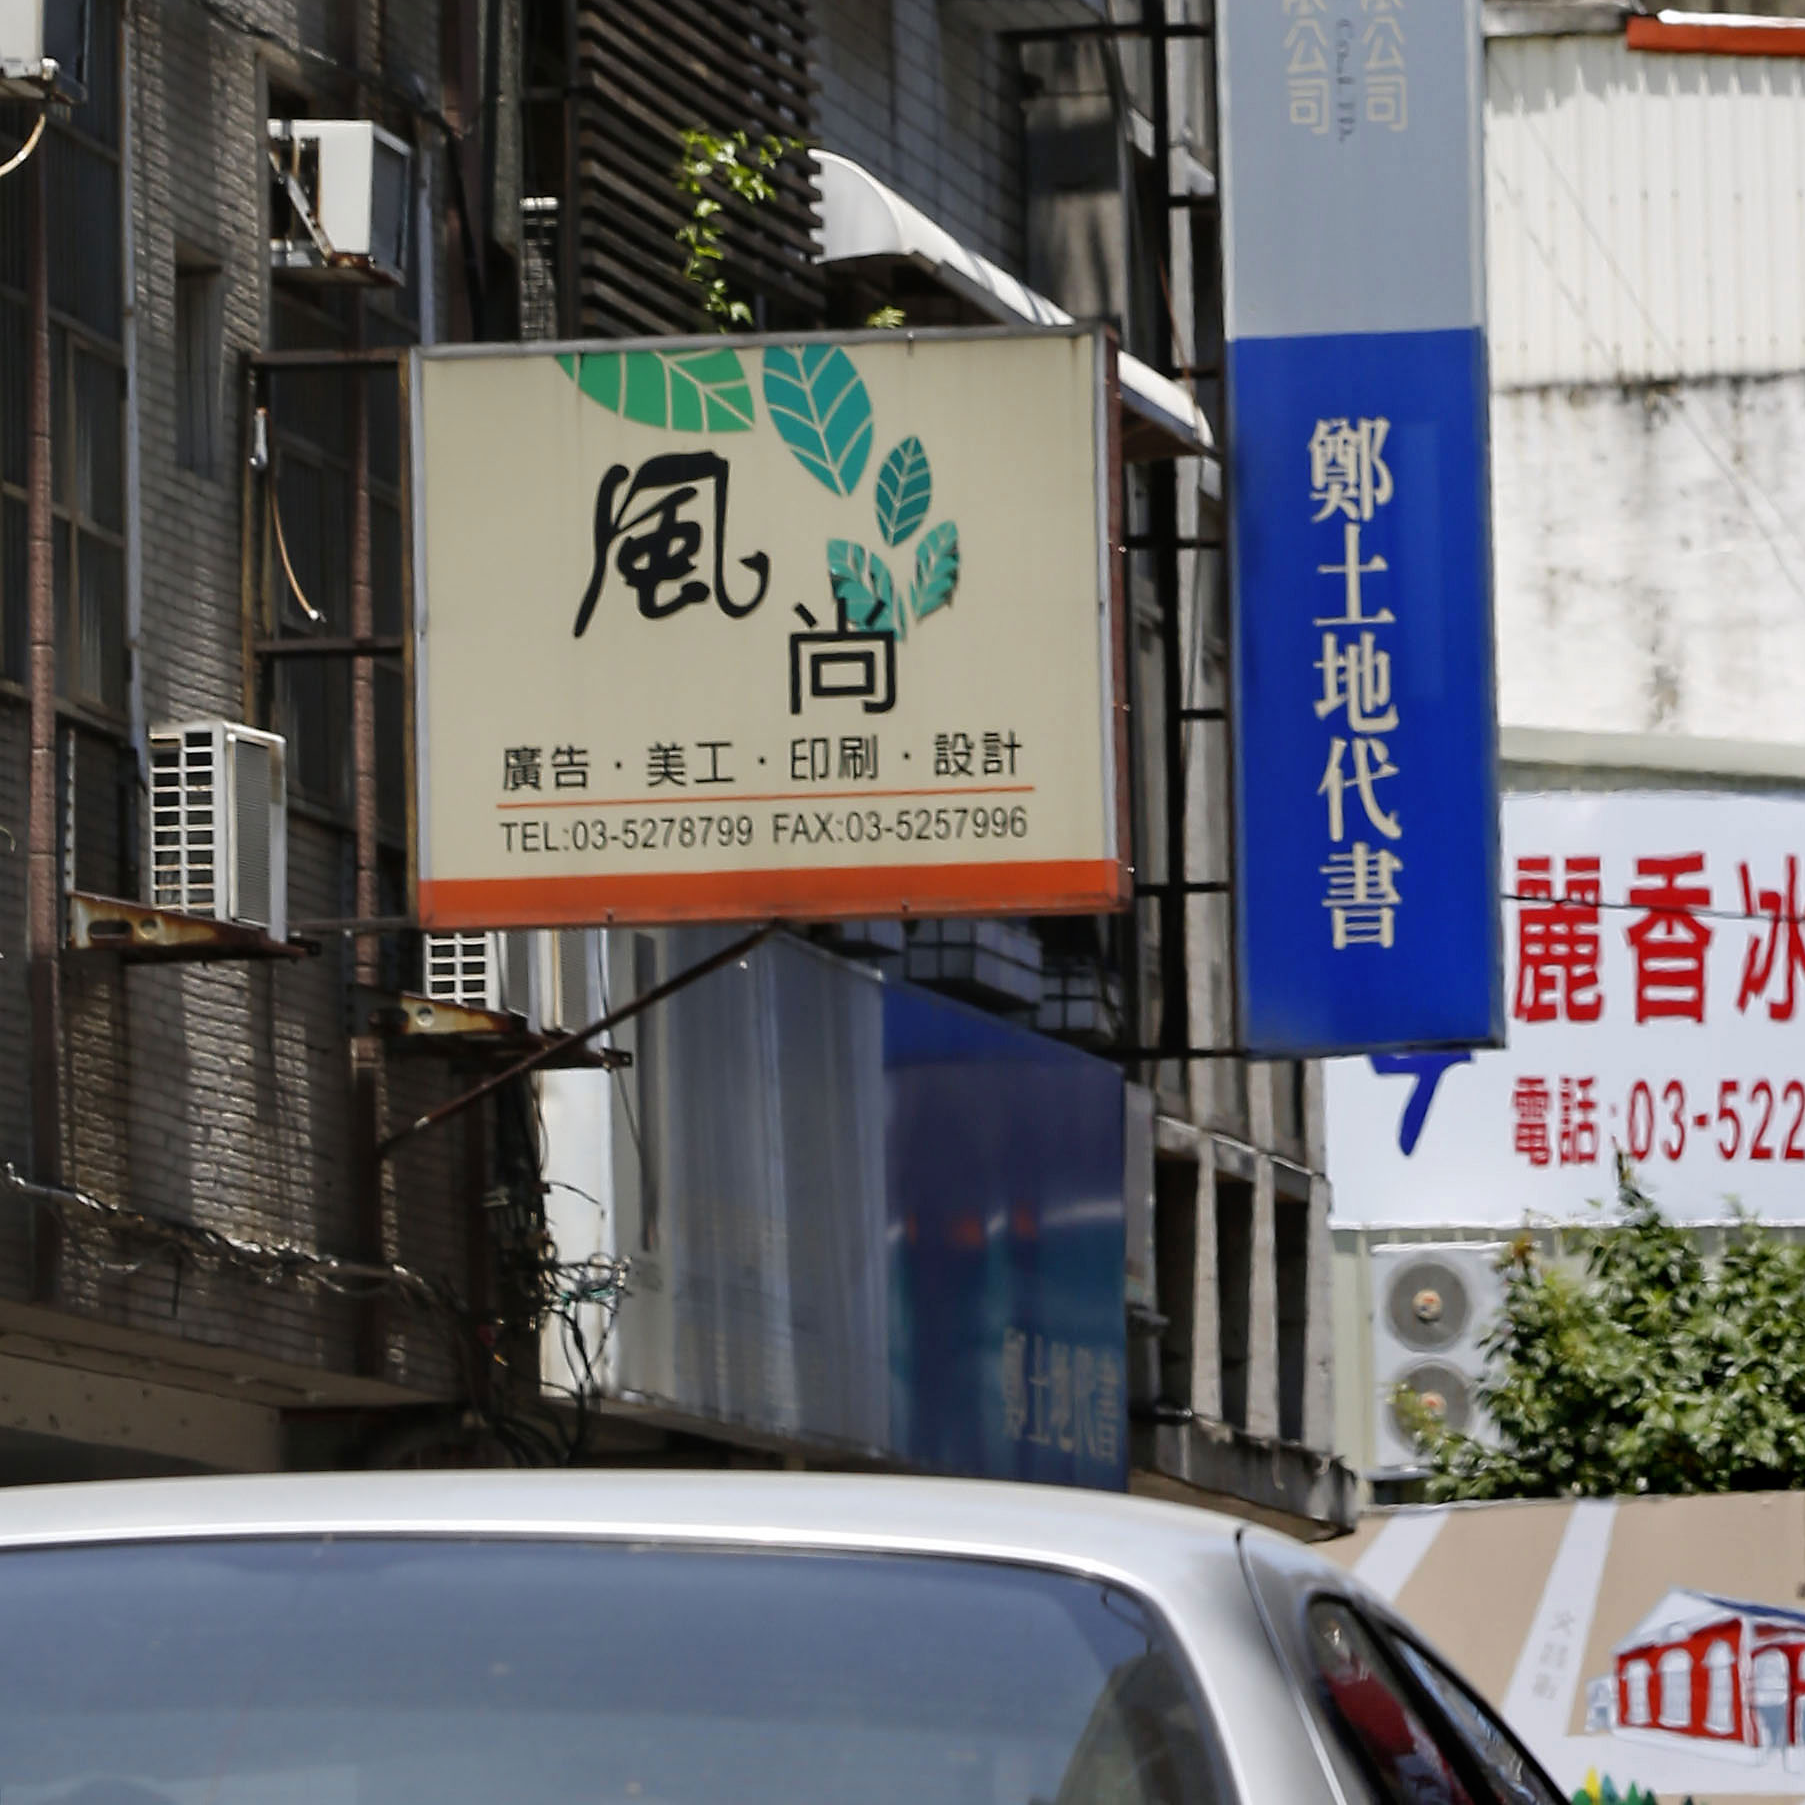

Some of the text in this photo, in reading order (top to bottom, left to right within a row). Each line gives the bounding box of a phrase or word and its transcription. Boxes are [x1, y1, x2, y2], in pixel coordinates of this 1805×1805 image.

[499, 805, 1029, 854] TEL:03-5278799 FAX:03-5257996
[1307, 416, 1405, 951] 鄭土地代書
